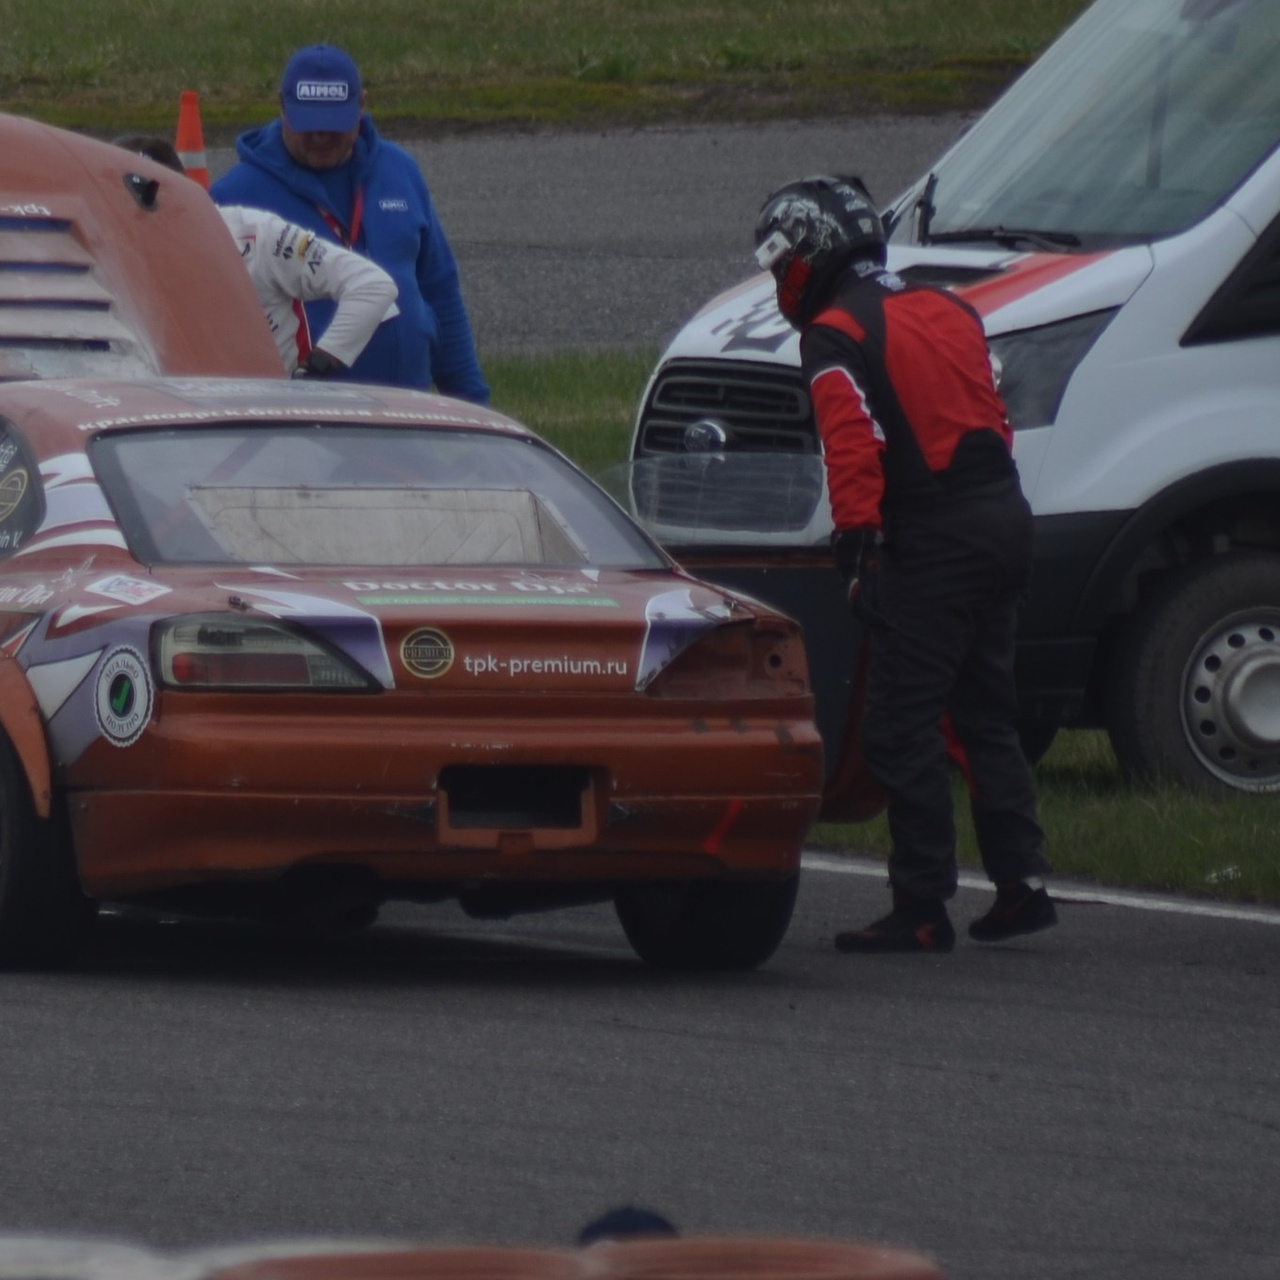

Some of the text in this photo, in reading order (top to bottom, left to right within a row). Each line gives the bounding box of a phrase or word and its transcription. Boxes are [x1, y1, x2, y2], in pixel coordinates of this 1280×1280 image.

[299, 83, 346, 98] AIMOL
[342, 580, 499, 593] Doctor
[404, 647, 451, 659] PREMIUM
[463, 655, 628, 677] tpk-premium.ru
